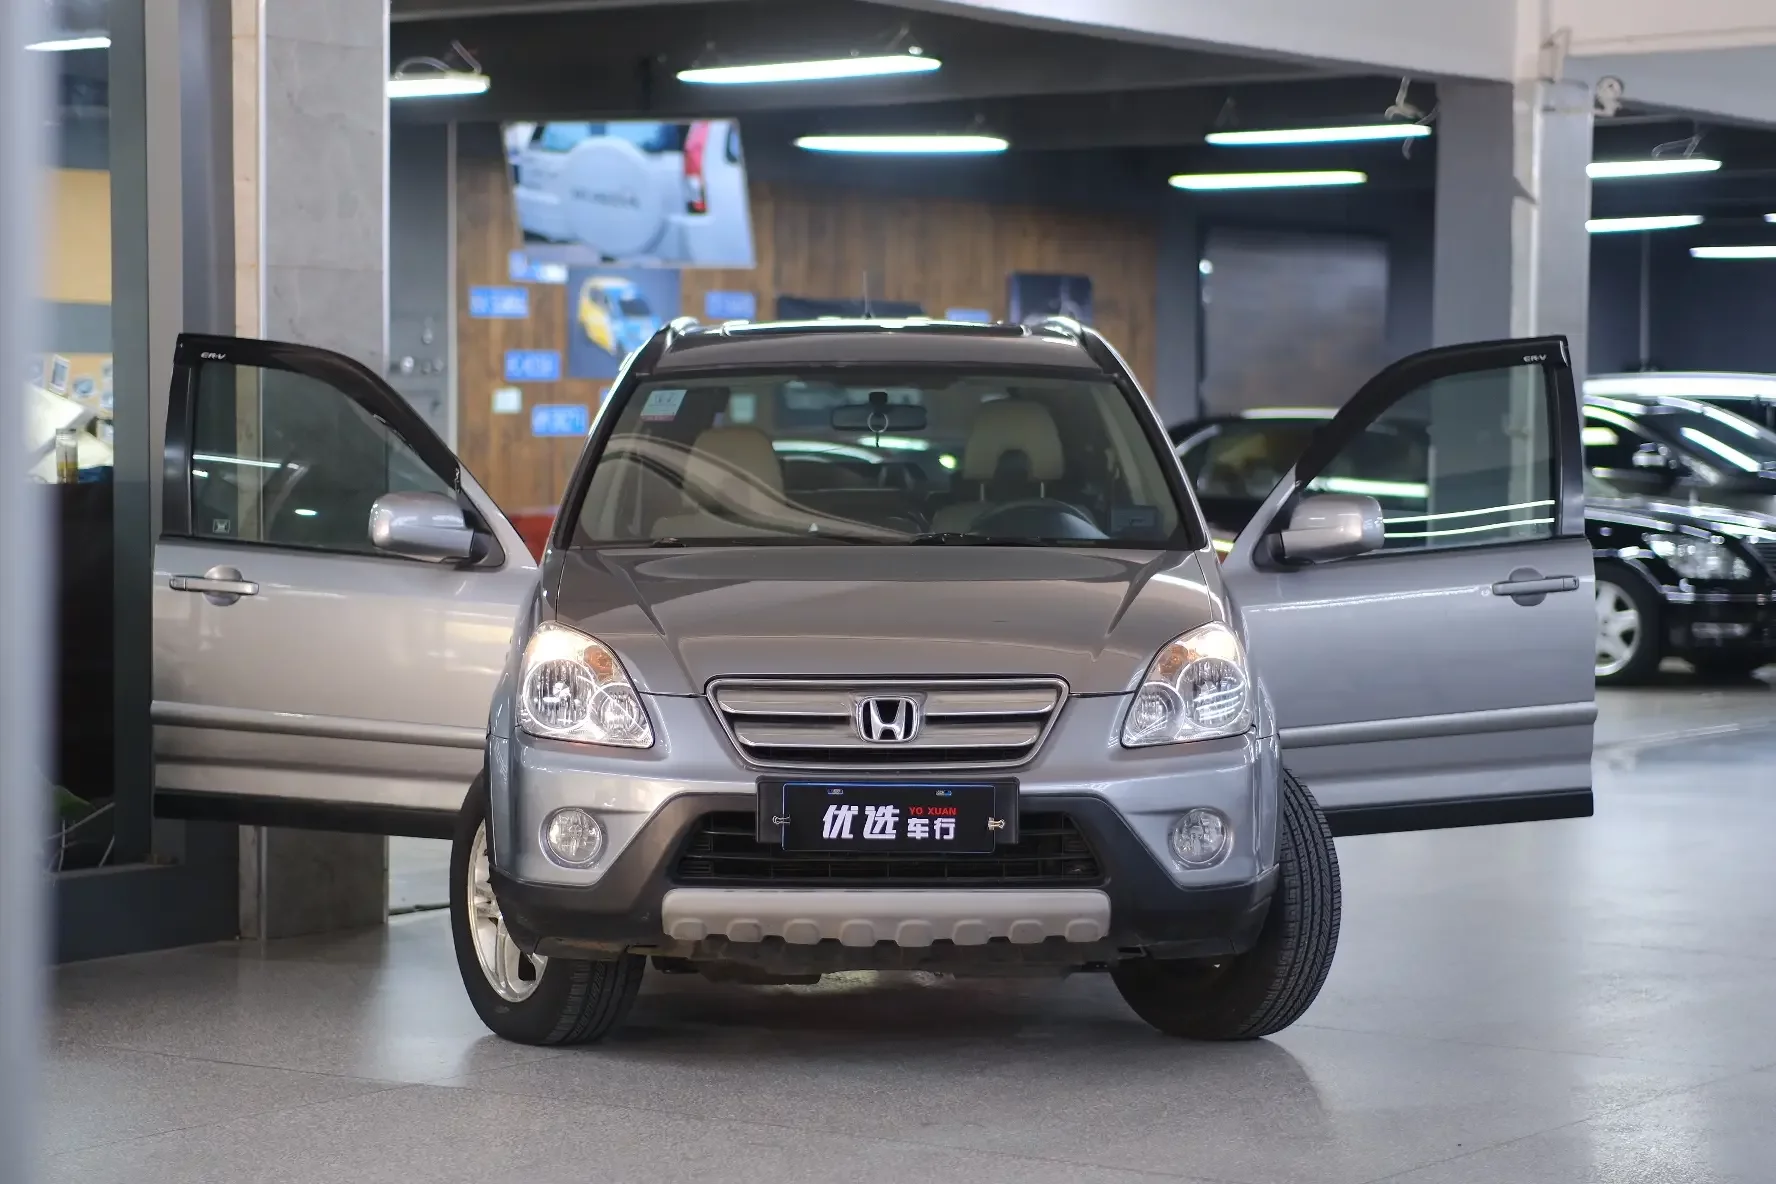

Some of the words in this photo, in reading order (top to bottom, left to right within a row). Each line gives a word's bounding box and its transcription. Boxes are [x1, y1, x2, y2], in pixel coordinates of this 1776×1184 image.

[822, 804, 900, 839] 优选
[907, 817, 956, 840] 车行
[909, 806, 923, 815] YO
[927, 807, 957, 816] XUAN
